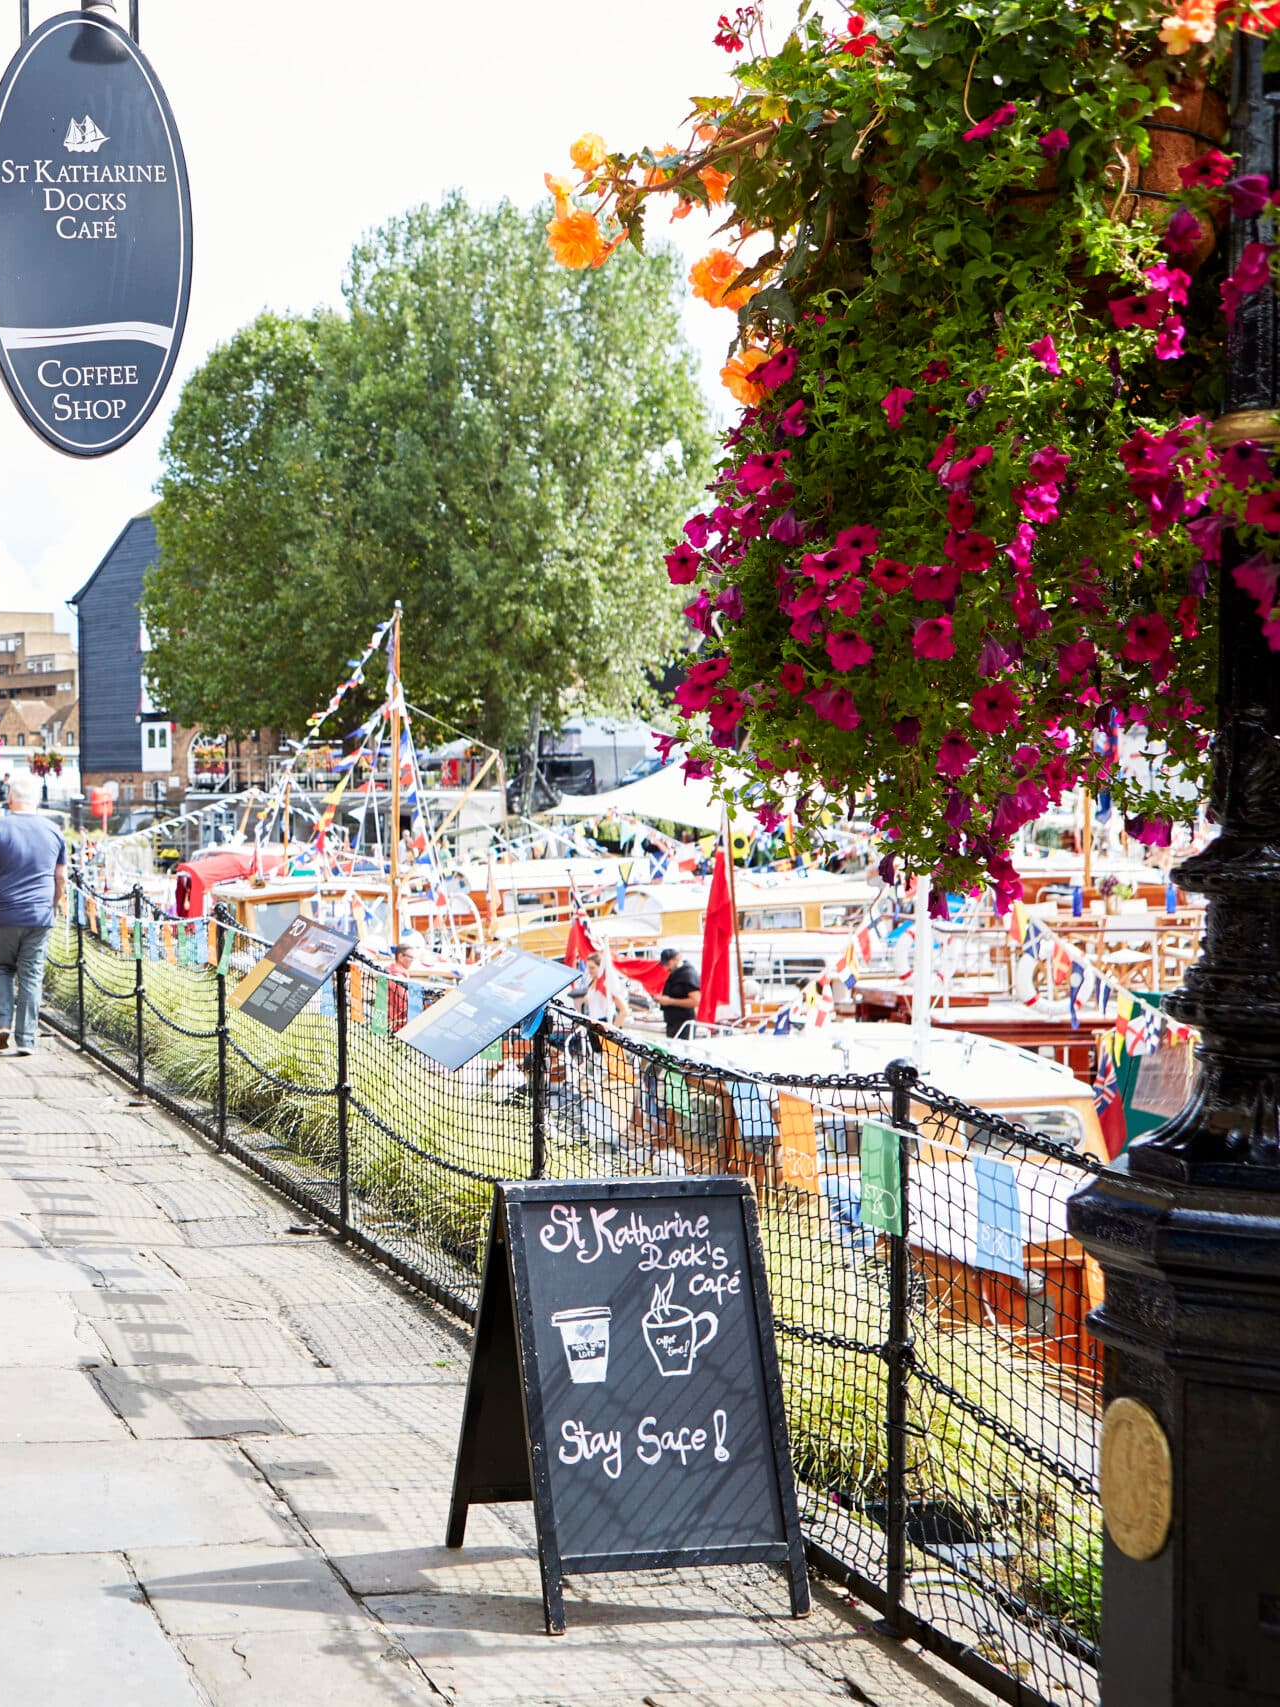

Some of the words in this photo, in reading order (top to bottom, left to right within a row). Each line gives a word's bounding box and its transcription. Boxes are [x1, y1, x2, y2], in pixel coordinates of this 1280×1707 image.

[33, 159, 167, 183] KATHARINE
[43, 188, 127, 211] DOCKS
[56, 215, 118, 239] CAFÉ
[37, 359, 139, 388] COFFEE
[53, 393, 127, 421] SHOP
[539, 1203, 586, 1254] St
[576, 1206, 710, 1264] Katharine
[558, 1419, 622, 1480] Stay
